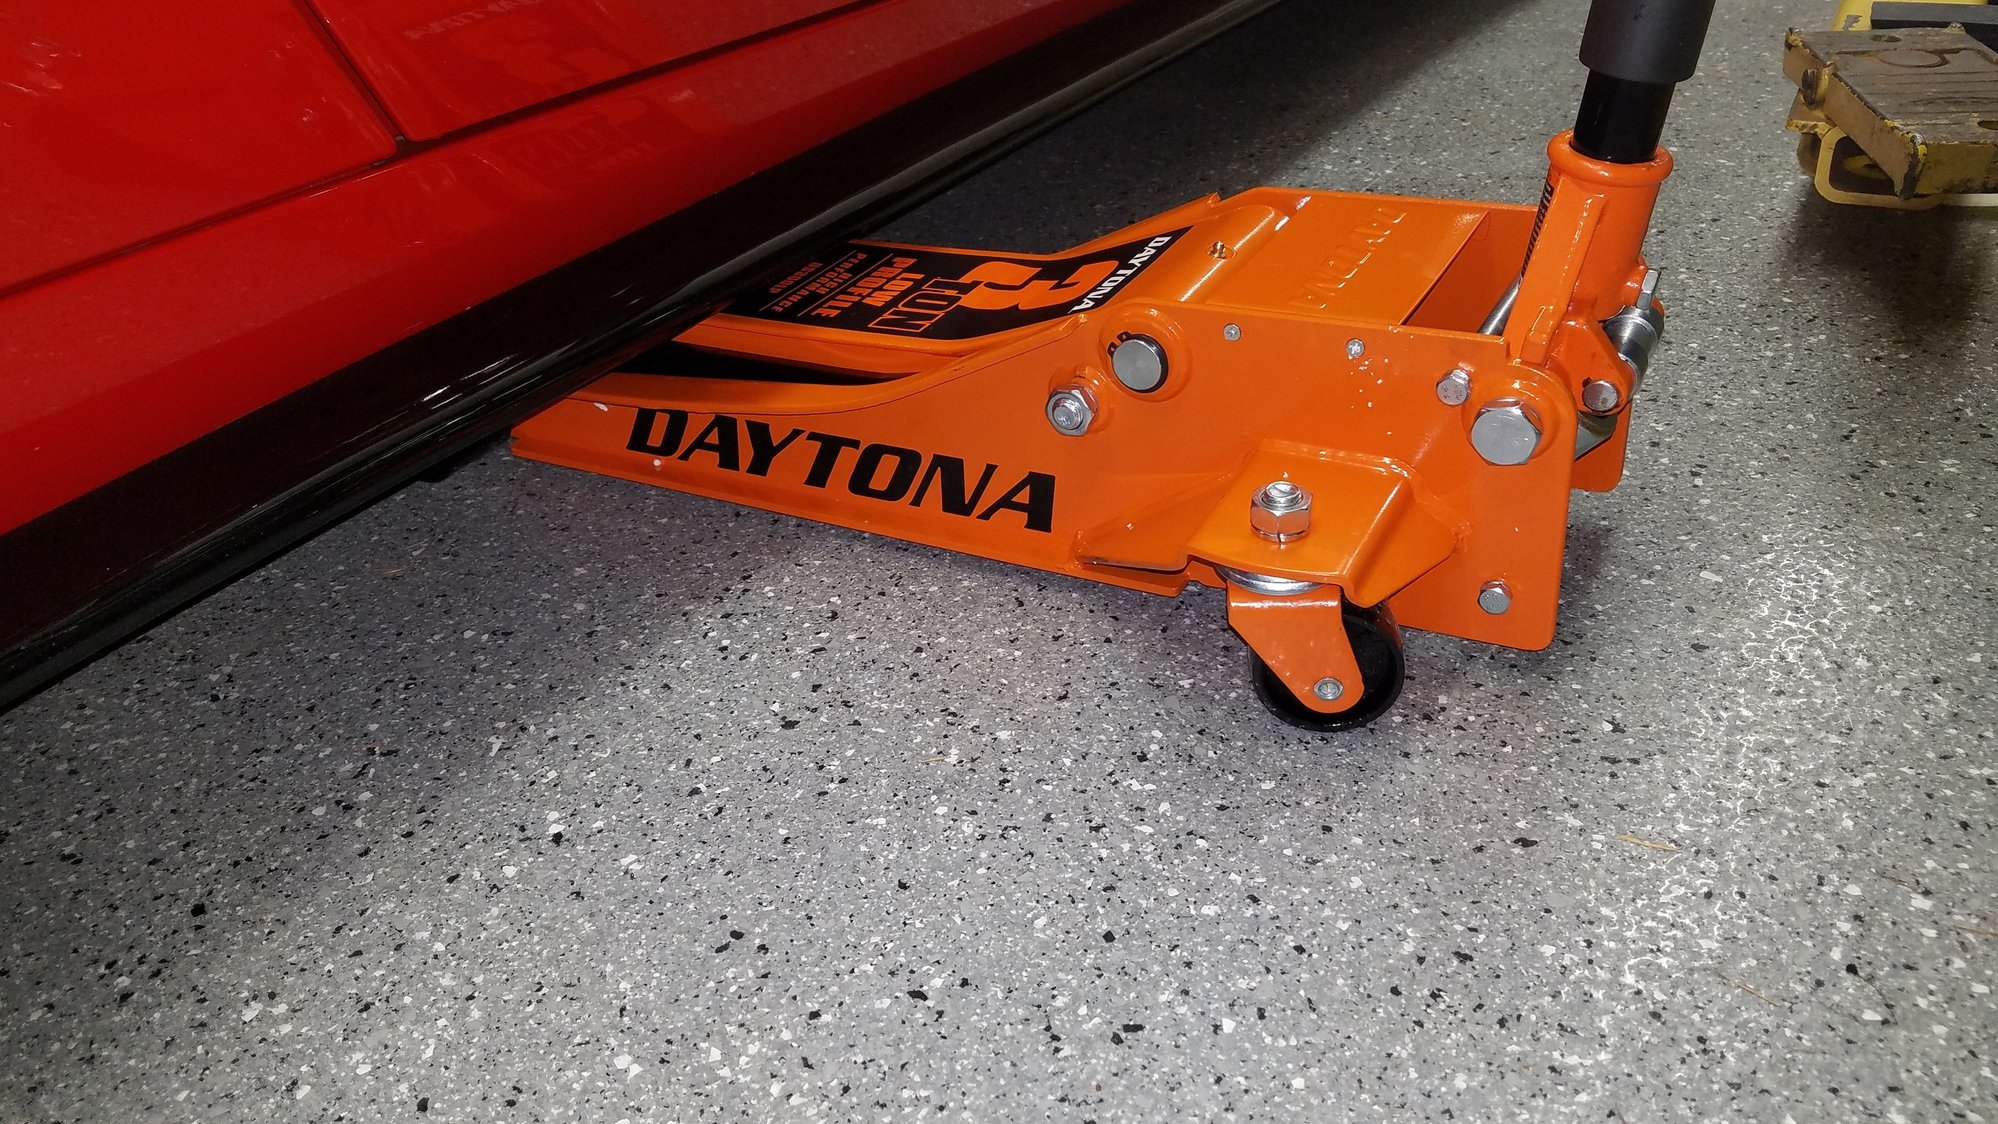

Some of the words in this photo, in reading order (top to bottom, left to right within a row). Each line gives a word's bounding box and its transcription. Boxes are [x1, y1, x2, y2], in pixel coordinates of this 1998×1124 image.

[771, 253, 868, 313] PERFORMANCE
[811, 257, 918, 319] PROFILE
[815, 272, 853, 294] HIGH
[861, 272, 925, 307] LOW
[958, 260, 1120, 311] 3
[1066, 236, 1173, 314] DAYTONA
[866, 278, 985, 333] TON
[625, 406, 1057, 534] DAYTONA
